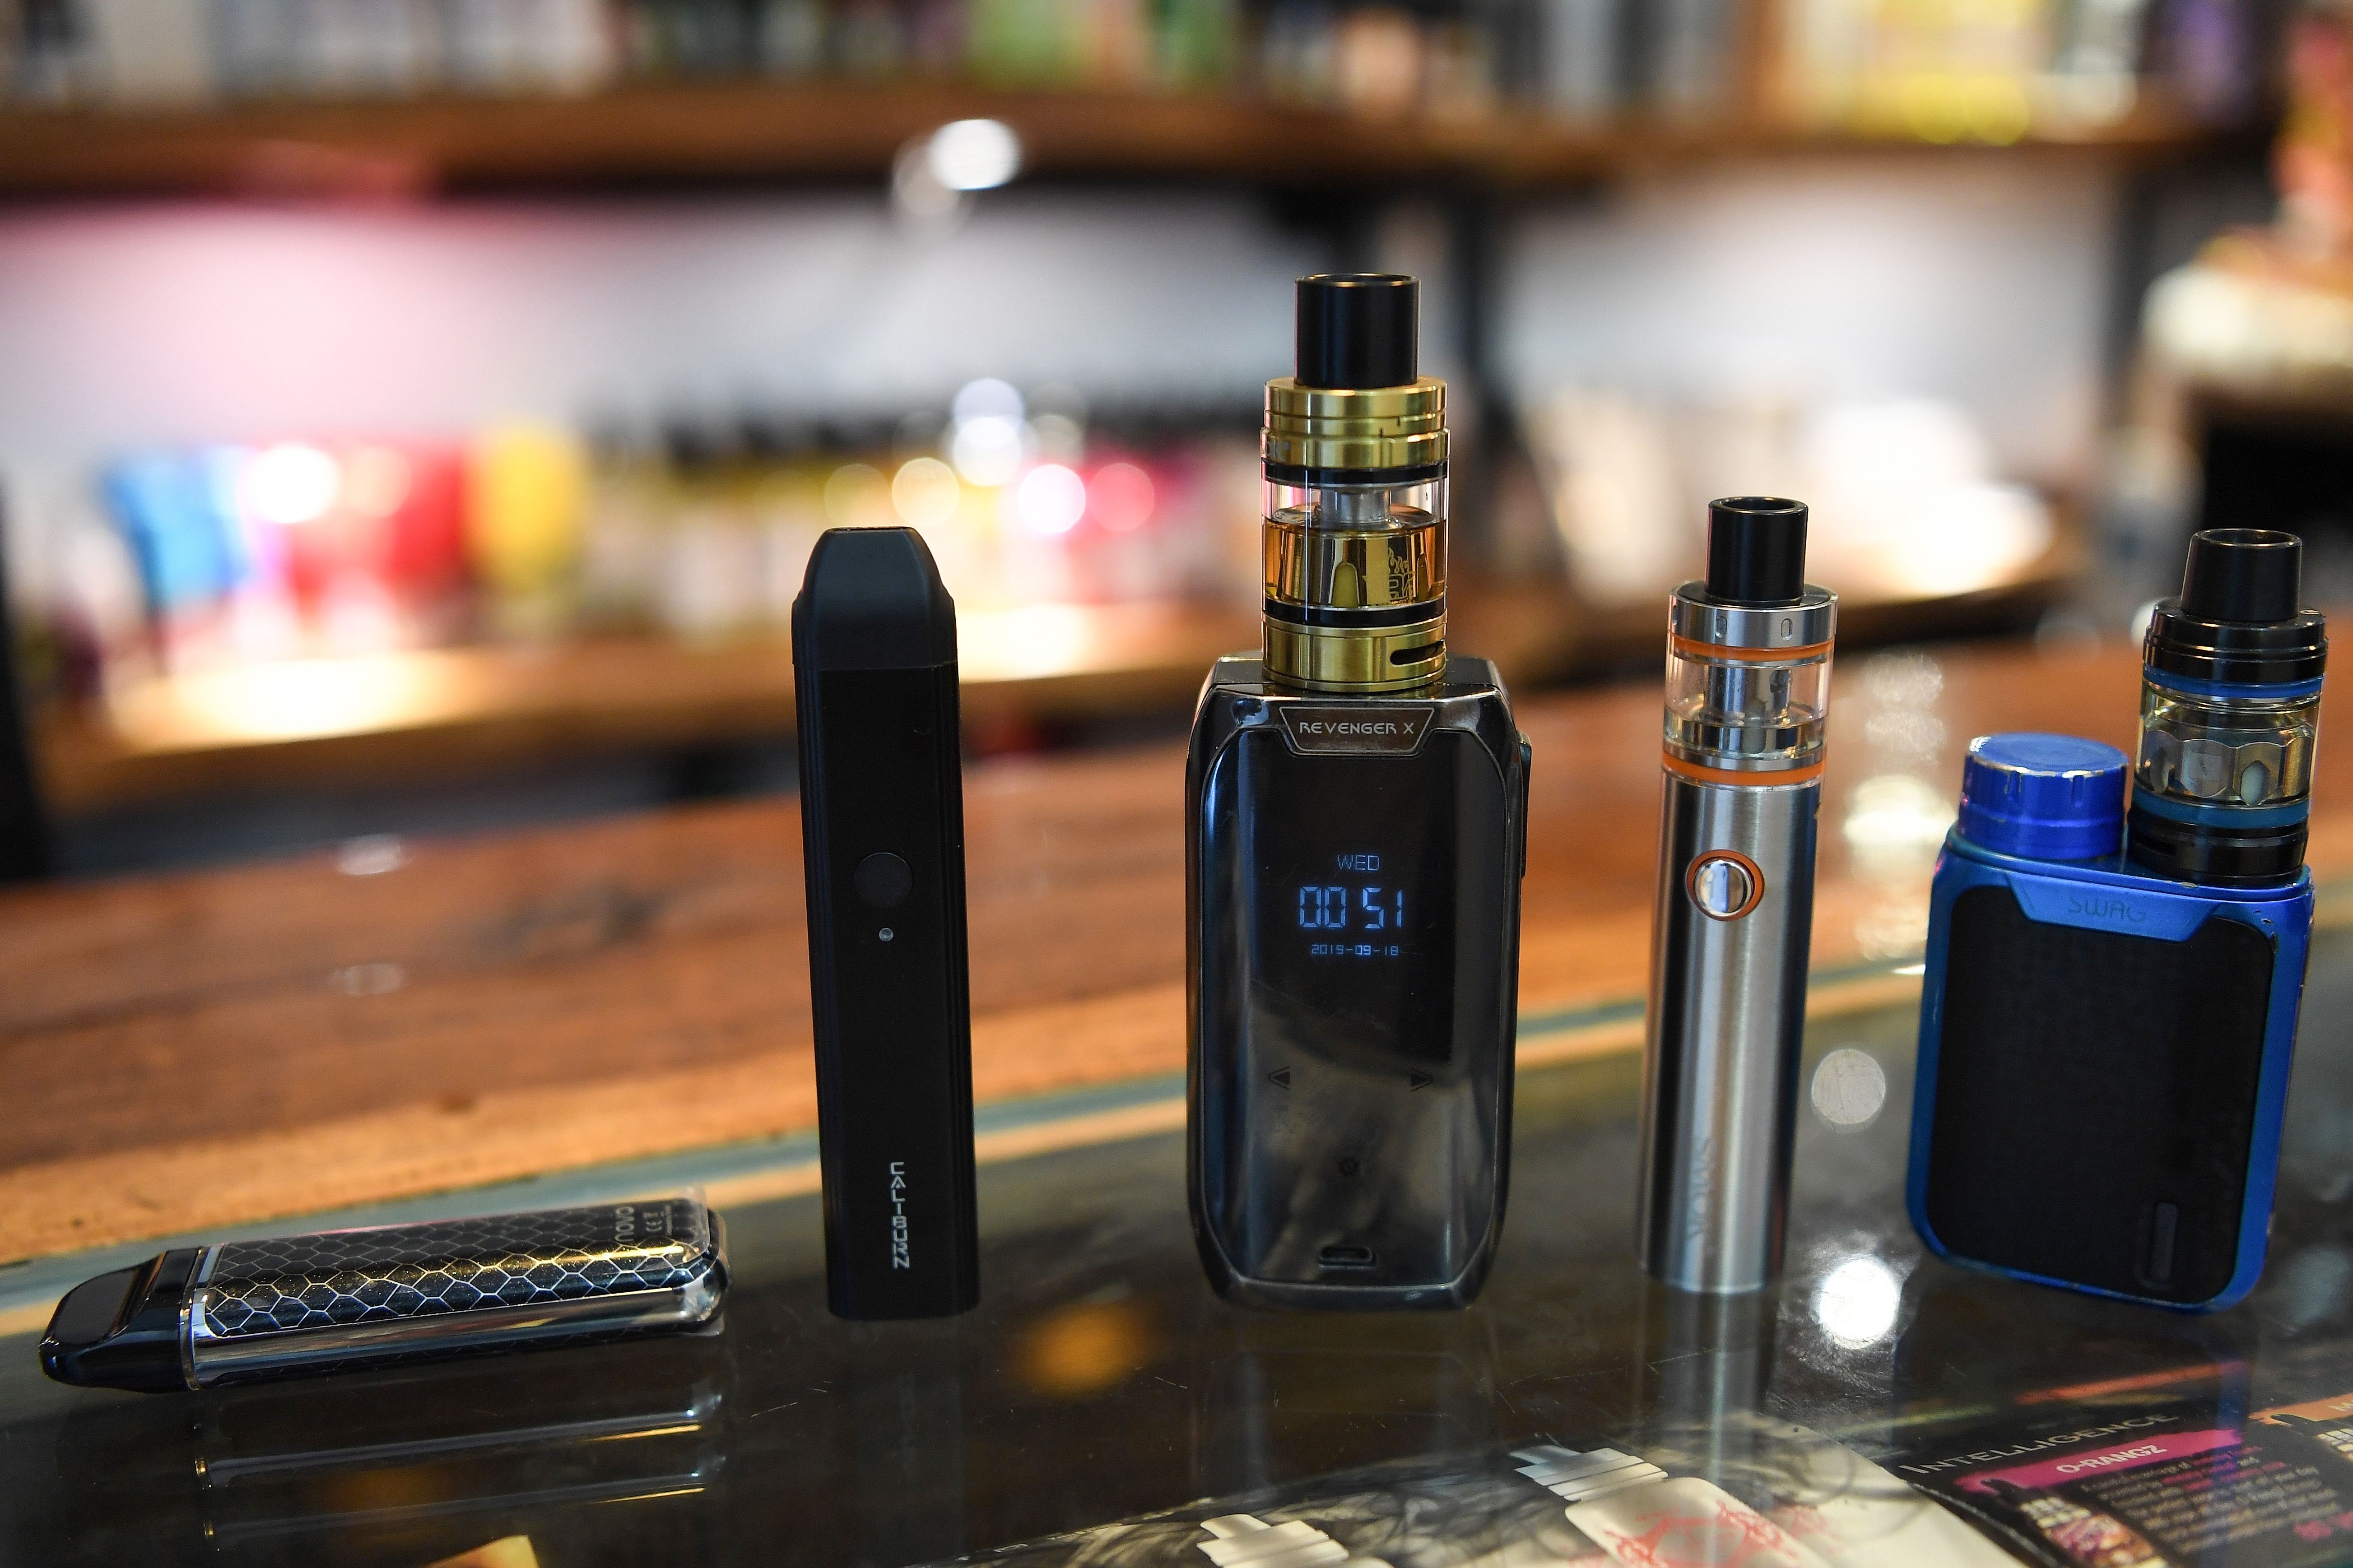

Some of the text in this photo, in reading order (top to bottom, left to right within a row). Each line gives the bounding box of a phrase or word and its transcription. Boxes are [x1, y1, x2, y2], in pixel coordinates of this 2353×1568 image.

[1300, 722, 1414, 735] REVENGER X
[1338, 854, 1380, 871] WED
[2068, 895, 2147, 923] SWAG
[1311, 944, 1399, 956] 2019-09-18
[890, 1162, 910, 1269] CALIBURN
[1899, 1414, 2179, 1474] INTELLIGENCE
